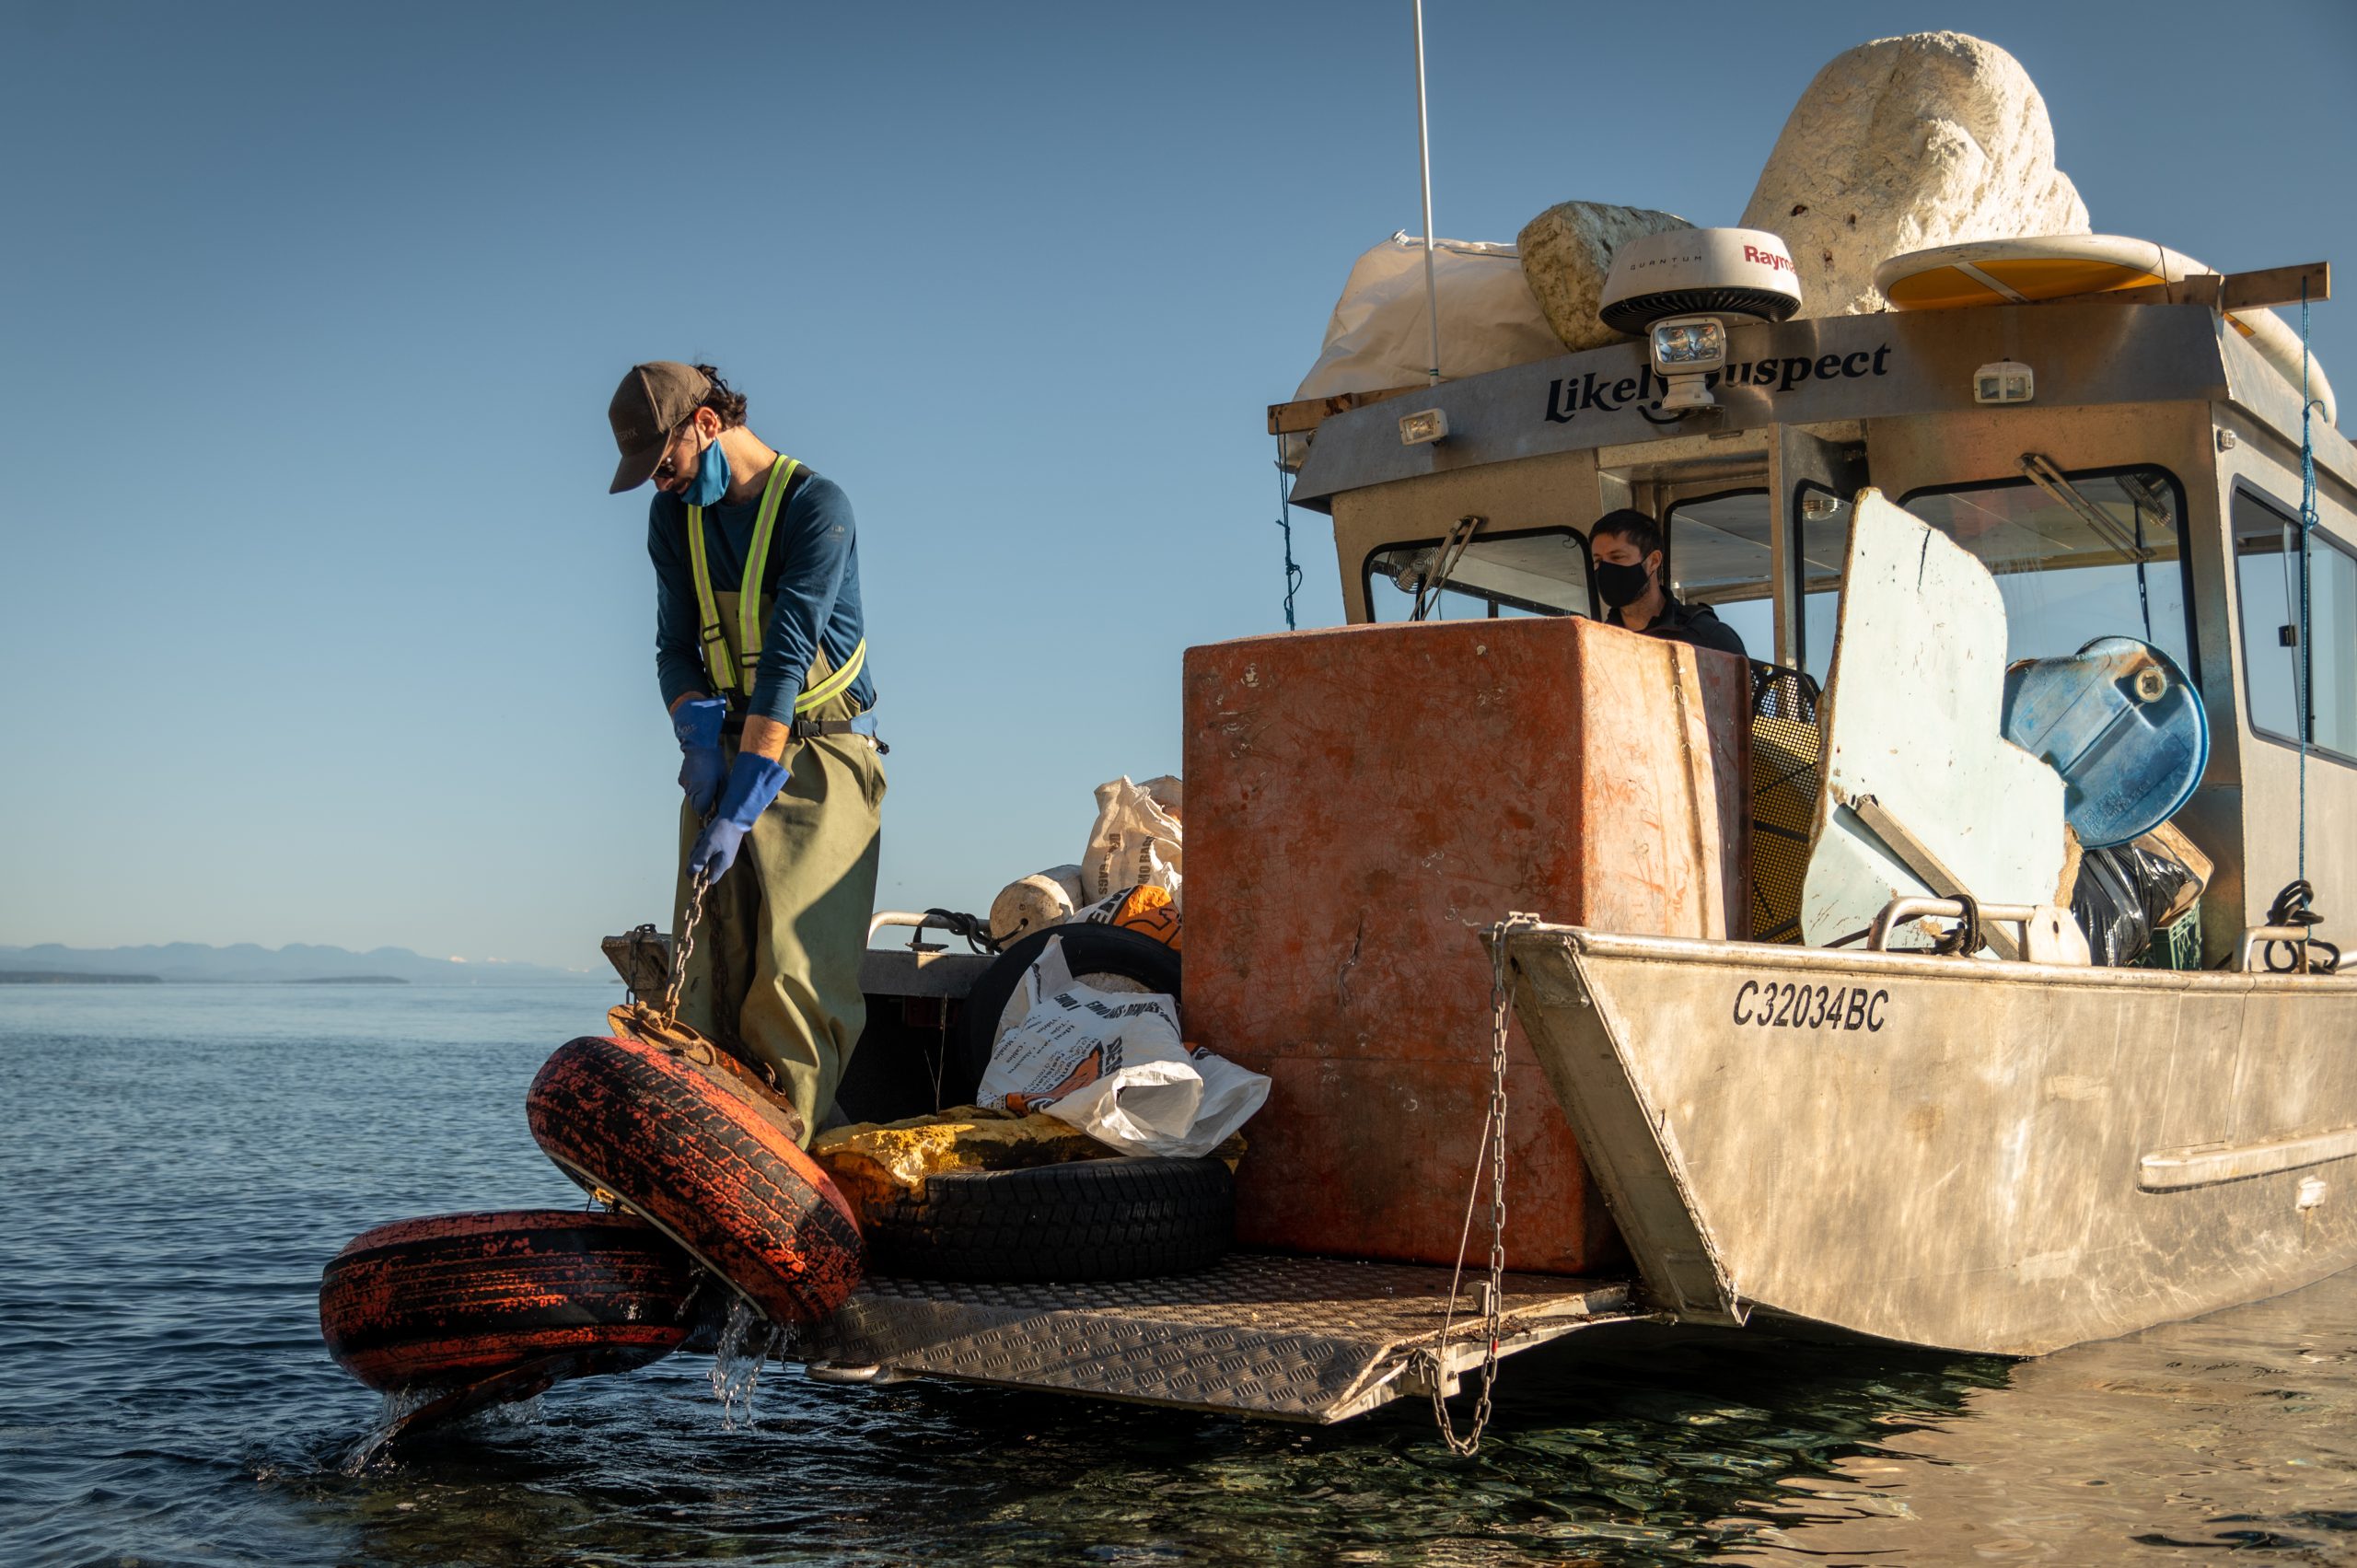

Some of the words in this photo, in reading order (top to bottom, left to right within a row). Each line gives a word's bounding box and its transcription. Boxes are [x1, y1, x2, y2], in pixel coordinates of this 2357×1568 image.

[1630, 255, 1702, 271] QUANTUM
[1733, 980, 1888, 1032] C32034BC
[993, 1040, 1015, 1061] Metales
[1005, 1044, 1024, 1063] Cables
